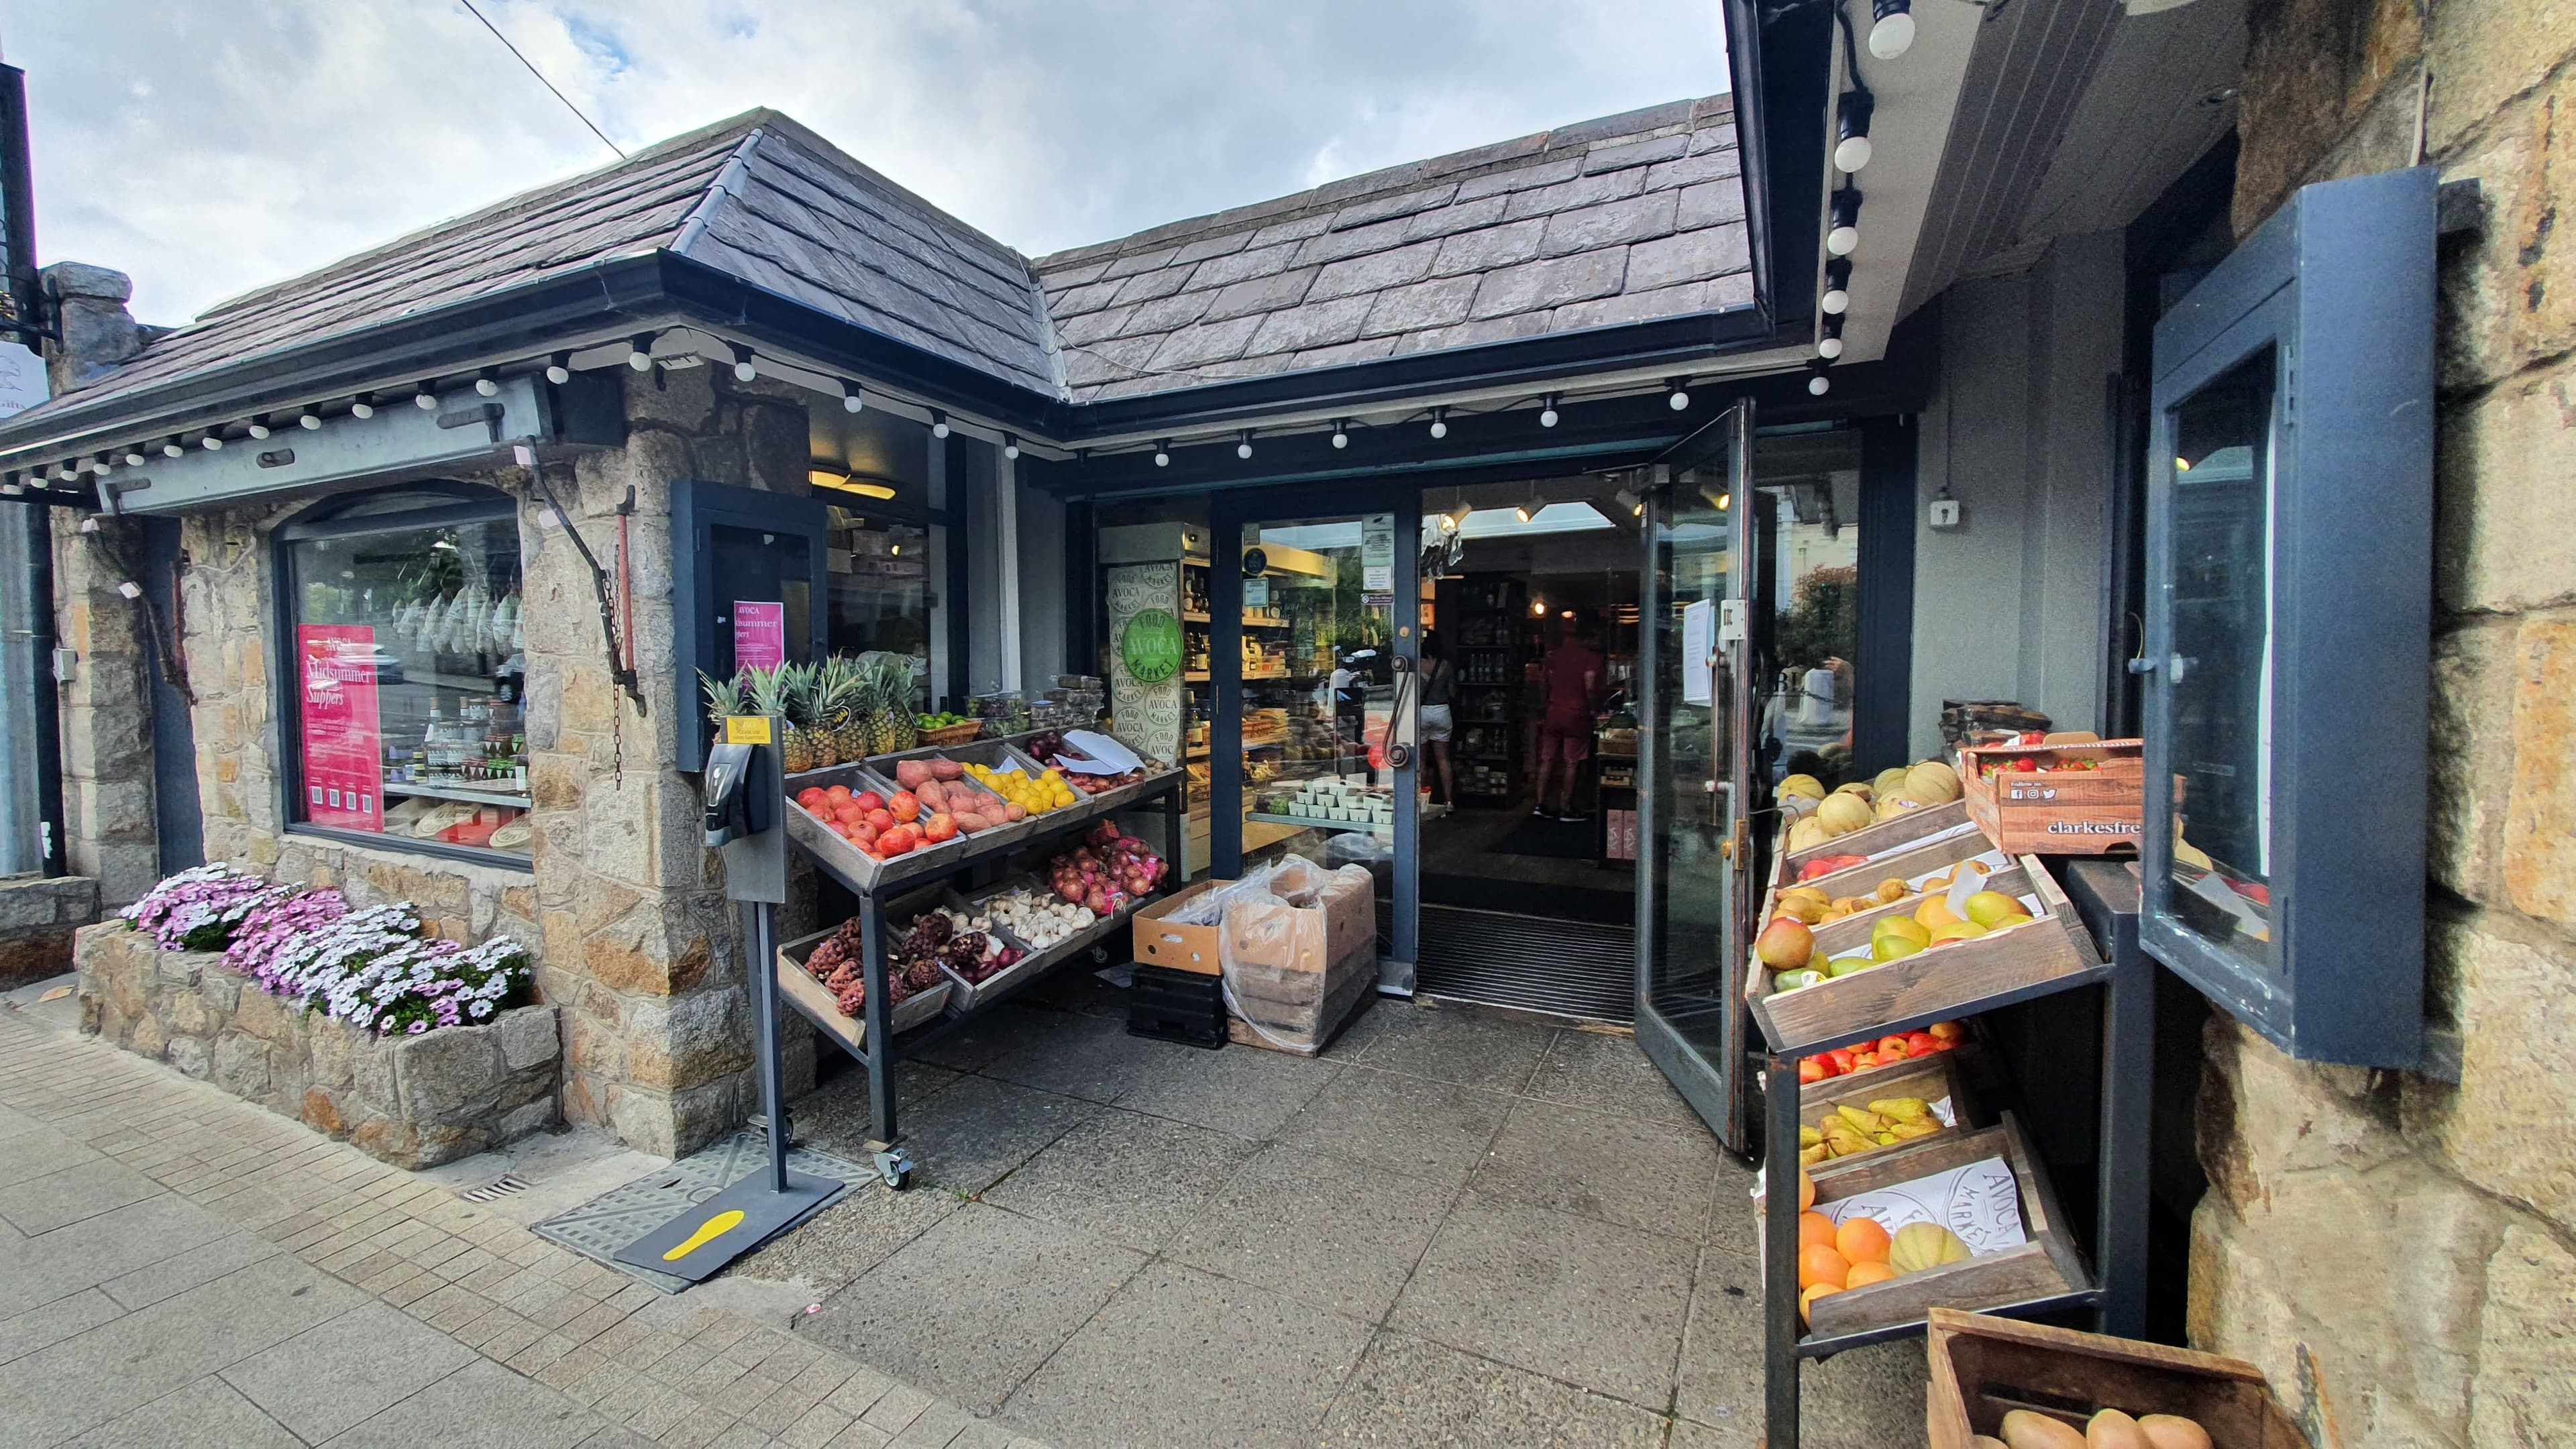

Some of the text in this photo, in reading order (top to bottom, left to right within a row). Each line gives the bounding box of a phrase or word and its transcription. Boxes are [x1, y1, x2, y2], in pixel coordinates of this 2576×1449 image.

[1112, 587, 1140, 598] AVOCA
[1150, 594, 1170, 604] FOOD
[739, 606, 760, 614] AVOCA
[1138, 613, 1166, 630] FOOD
[1128, 637, 1178, 655] AVOCA
[306, 659, 370, 683] Midsummer
[1131, 658, 1174, 680] MARKET
[1115, 678, 1142, 688] AVOCA
[1117, 689, 1142, 702] MARKET
[1153, 686, 1171, 696] FOOD
[307, 685, 344, 710] Suppers
[1148, 700, 1177, 709] AVOCA
[1121, 709, 1139, 720] FOOD
[1150, 711, 1177, 723] MARKET
[1116, 722, 1144, 733] AVOCA
[1155, 732, 1174, 742] FOOD
[1150, 745, 1174, 755] AVOC
[2047, 820, 2141, 835] clarkesfre
[1982, 1174, 2019, 1238] AVOCA
[1951, 1185, 1992, 1246] MARKET
